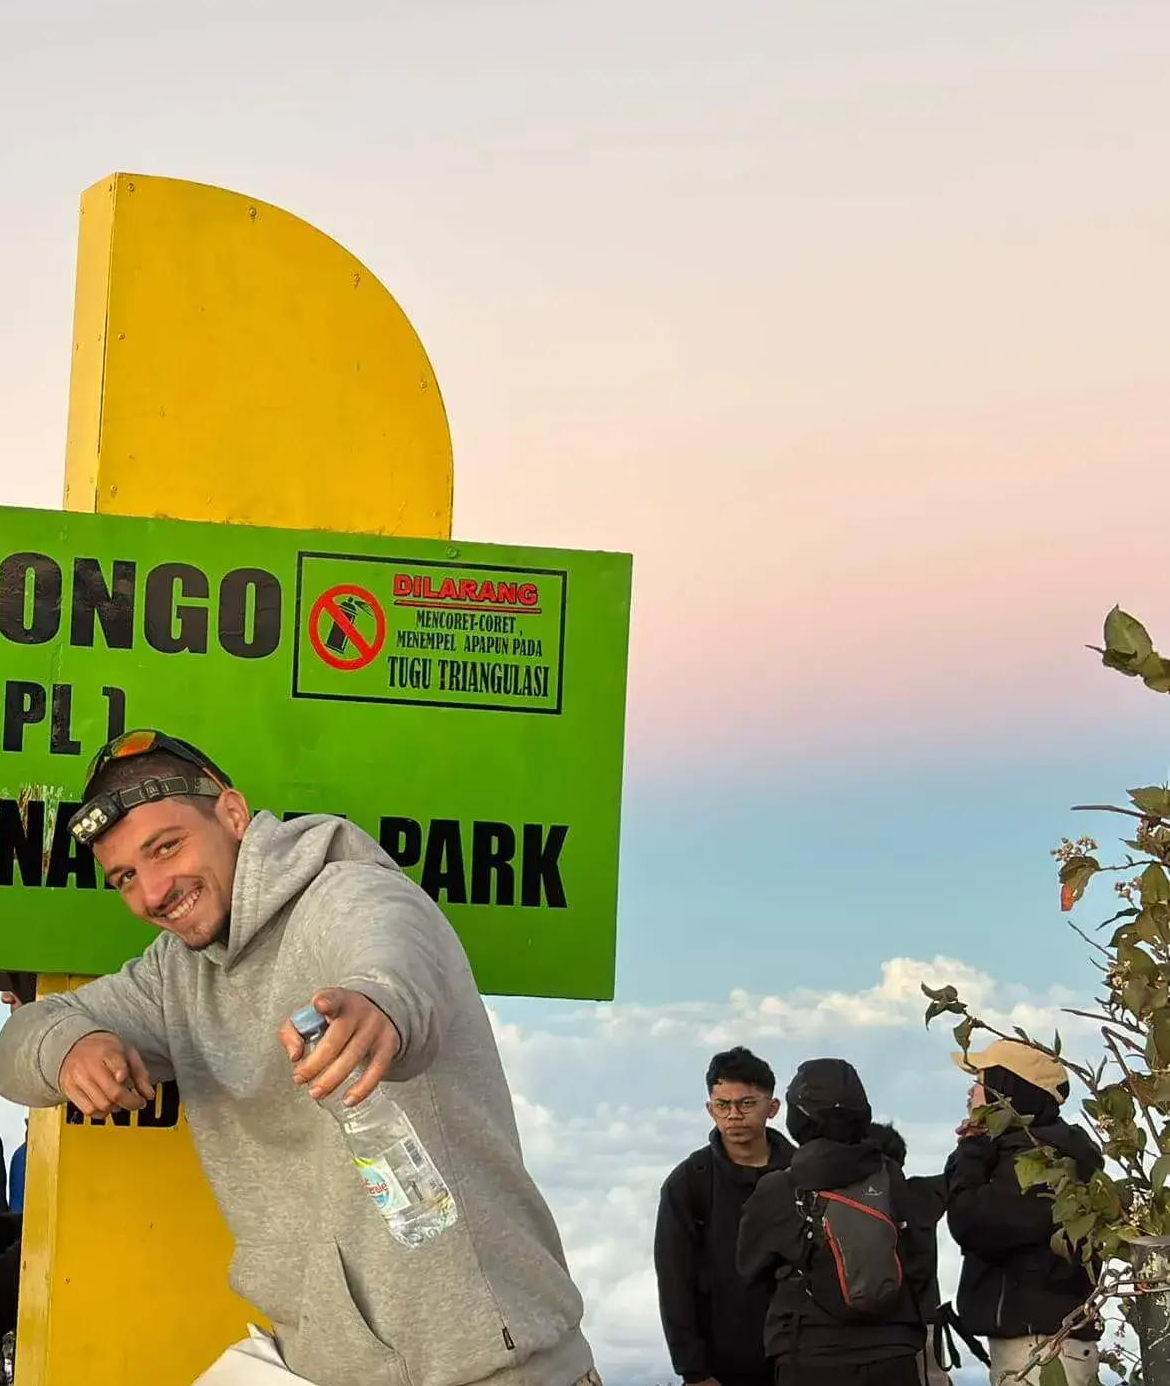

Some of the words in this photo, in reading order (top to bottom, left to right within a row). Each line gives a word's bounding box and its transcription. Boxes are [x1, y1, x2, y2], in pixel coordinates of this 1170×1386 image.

[393, 573, 538, 606] DILARANG
[397, 630, 457, 652] MENEMPEL
[463, 636, 509, 654] APAPUN
[512, 639, 543, 657] PADA
[387, 656, 433, 690] TUGU
[438, 659, 550, 698] TRIANGULASI
[379, 815, 570, 909] PARK
